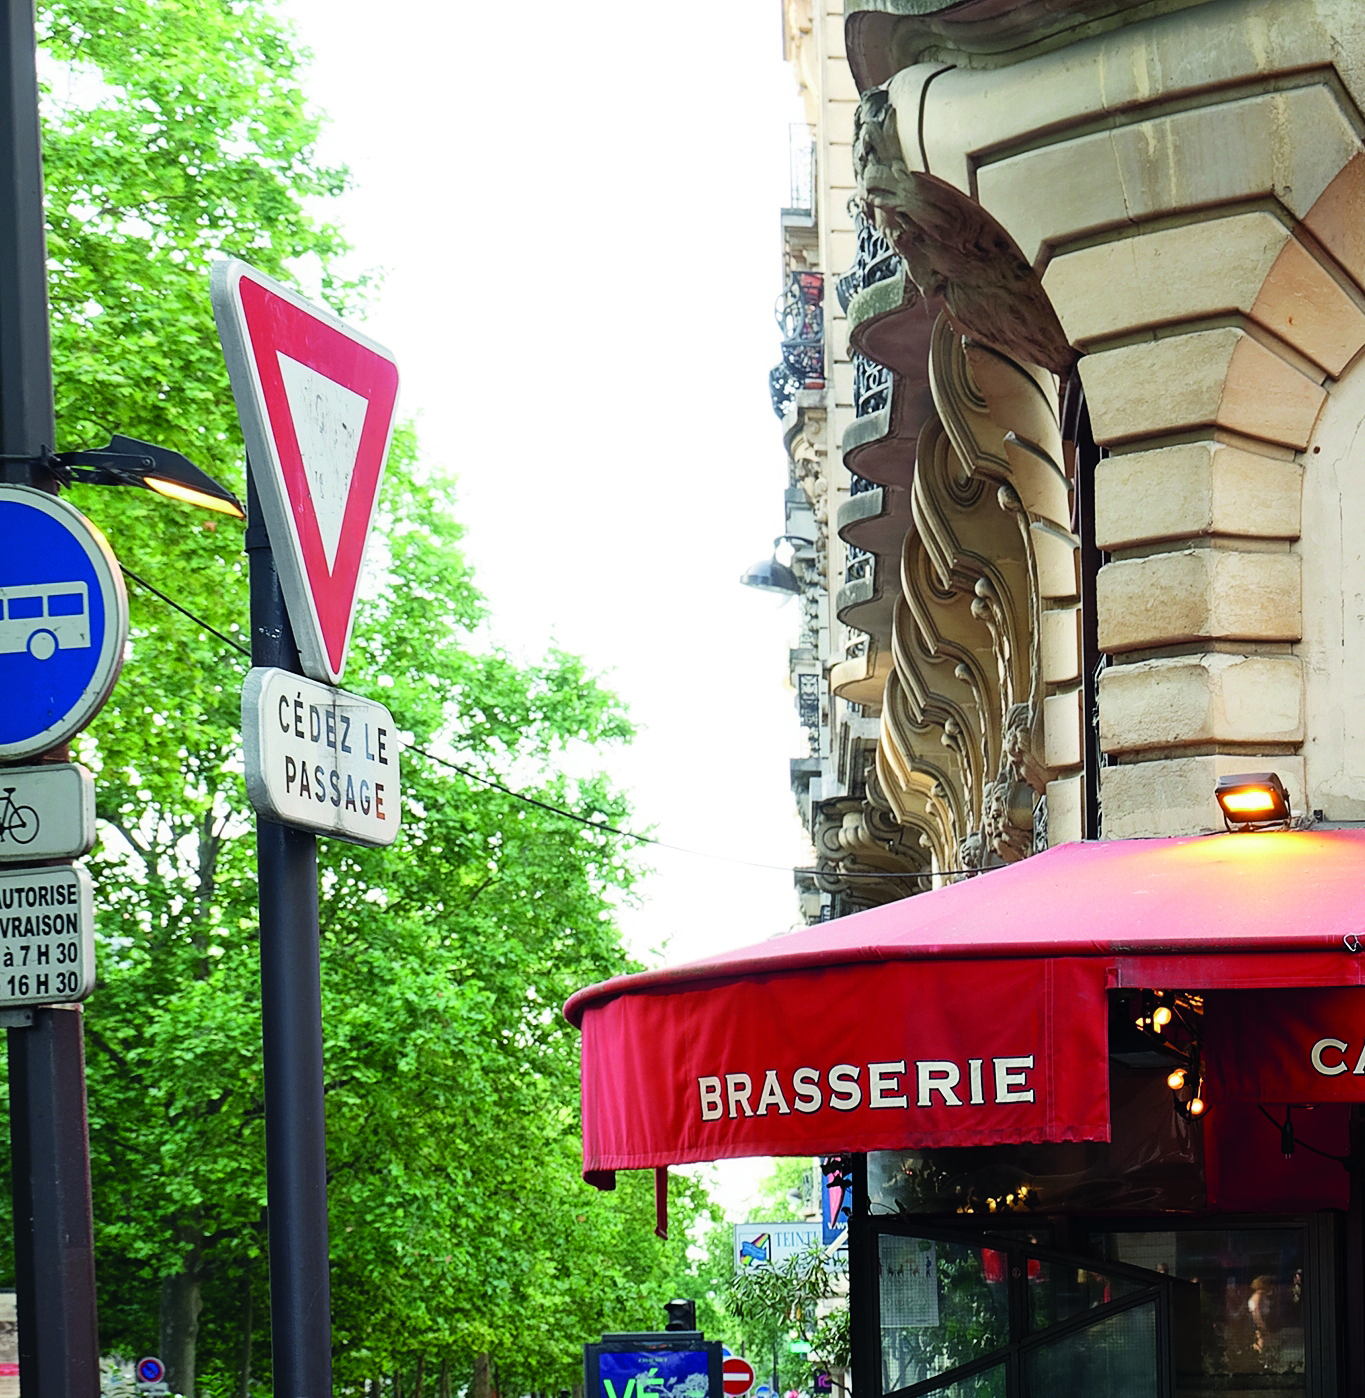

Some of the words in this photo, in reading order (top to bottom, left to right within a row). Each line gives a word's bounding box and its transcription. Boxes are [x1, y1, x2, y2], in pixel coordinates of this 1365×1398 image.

[279, 692, 352, 754] CÉDEZ
[365, 723, 388, 765] LE
[285, 756, 386, 821] PASSAGE
[0, 884, 77, 909] UTORISE
[3, 946, 14, 967] à
[20, 945, 31, 966] 7
[37, 944, 49, 965] H
[56, 942, 78, 964] 30
[7, 974, 29, 996] 16
[36, 973, 49, 994] H
[56, 971, 78, 993] 30
[697, 1055, 1036, 1122] BRASSERIE
